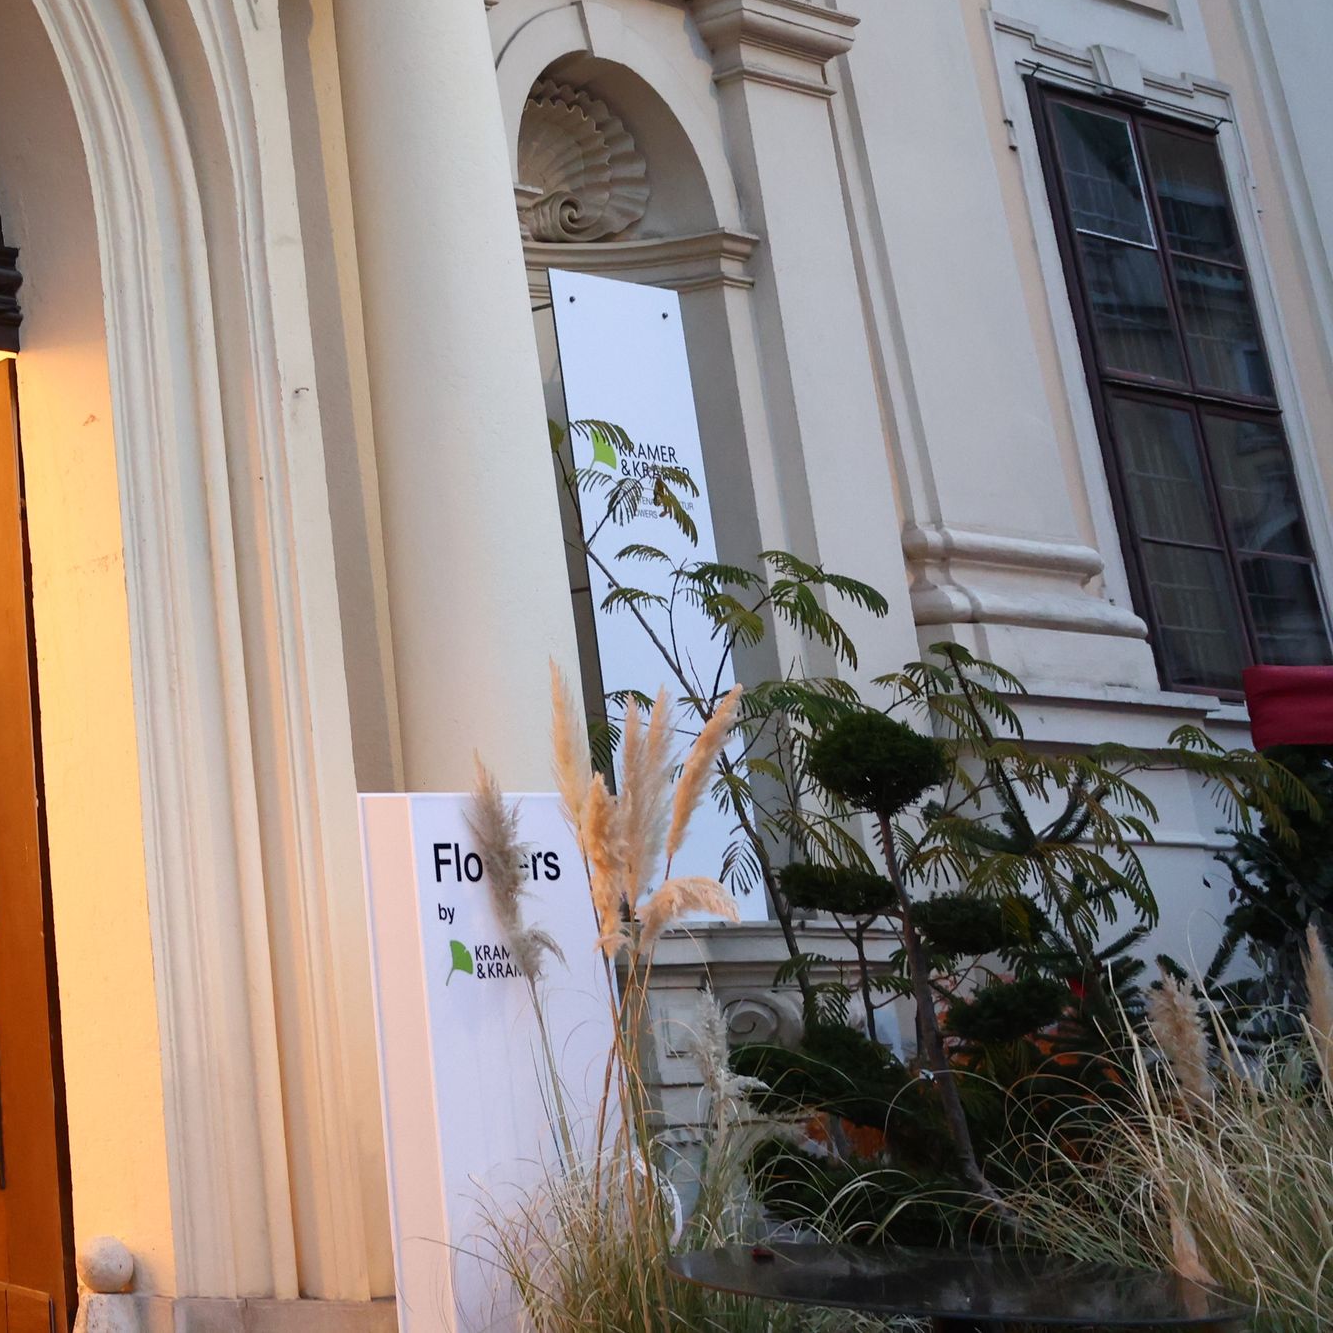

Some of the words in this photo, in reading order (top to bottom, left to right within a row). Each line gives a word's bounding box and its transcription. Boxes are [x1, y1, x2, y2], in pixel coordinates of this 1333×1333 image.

[433, 842, 561, 883] Flors
[438, 902, 455, 925] by
[474, 944, 513, 961] KRAM
